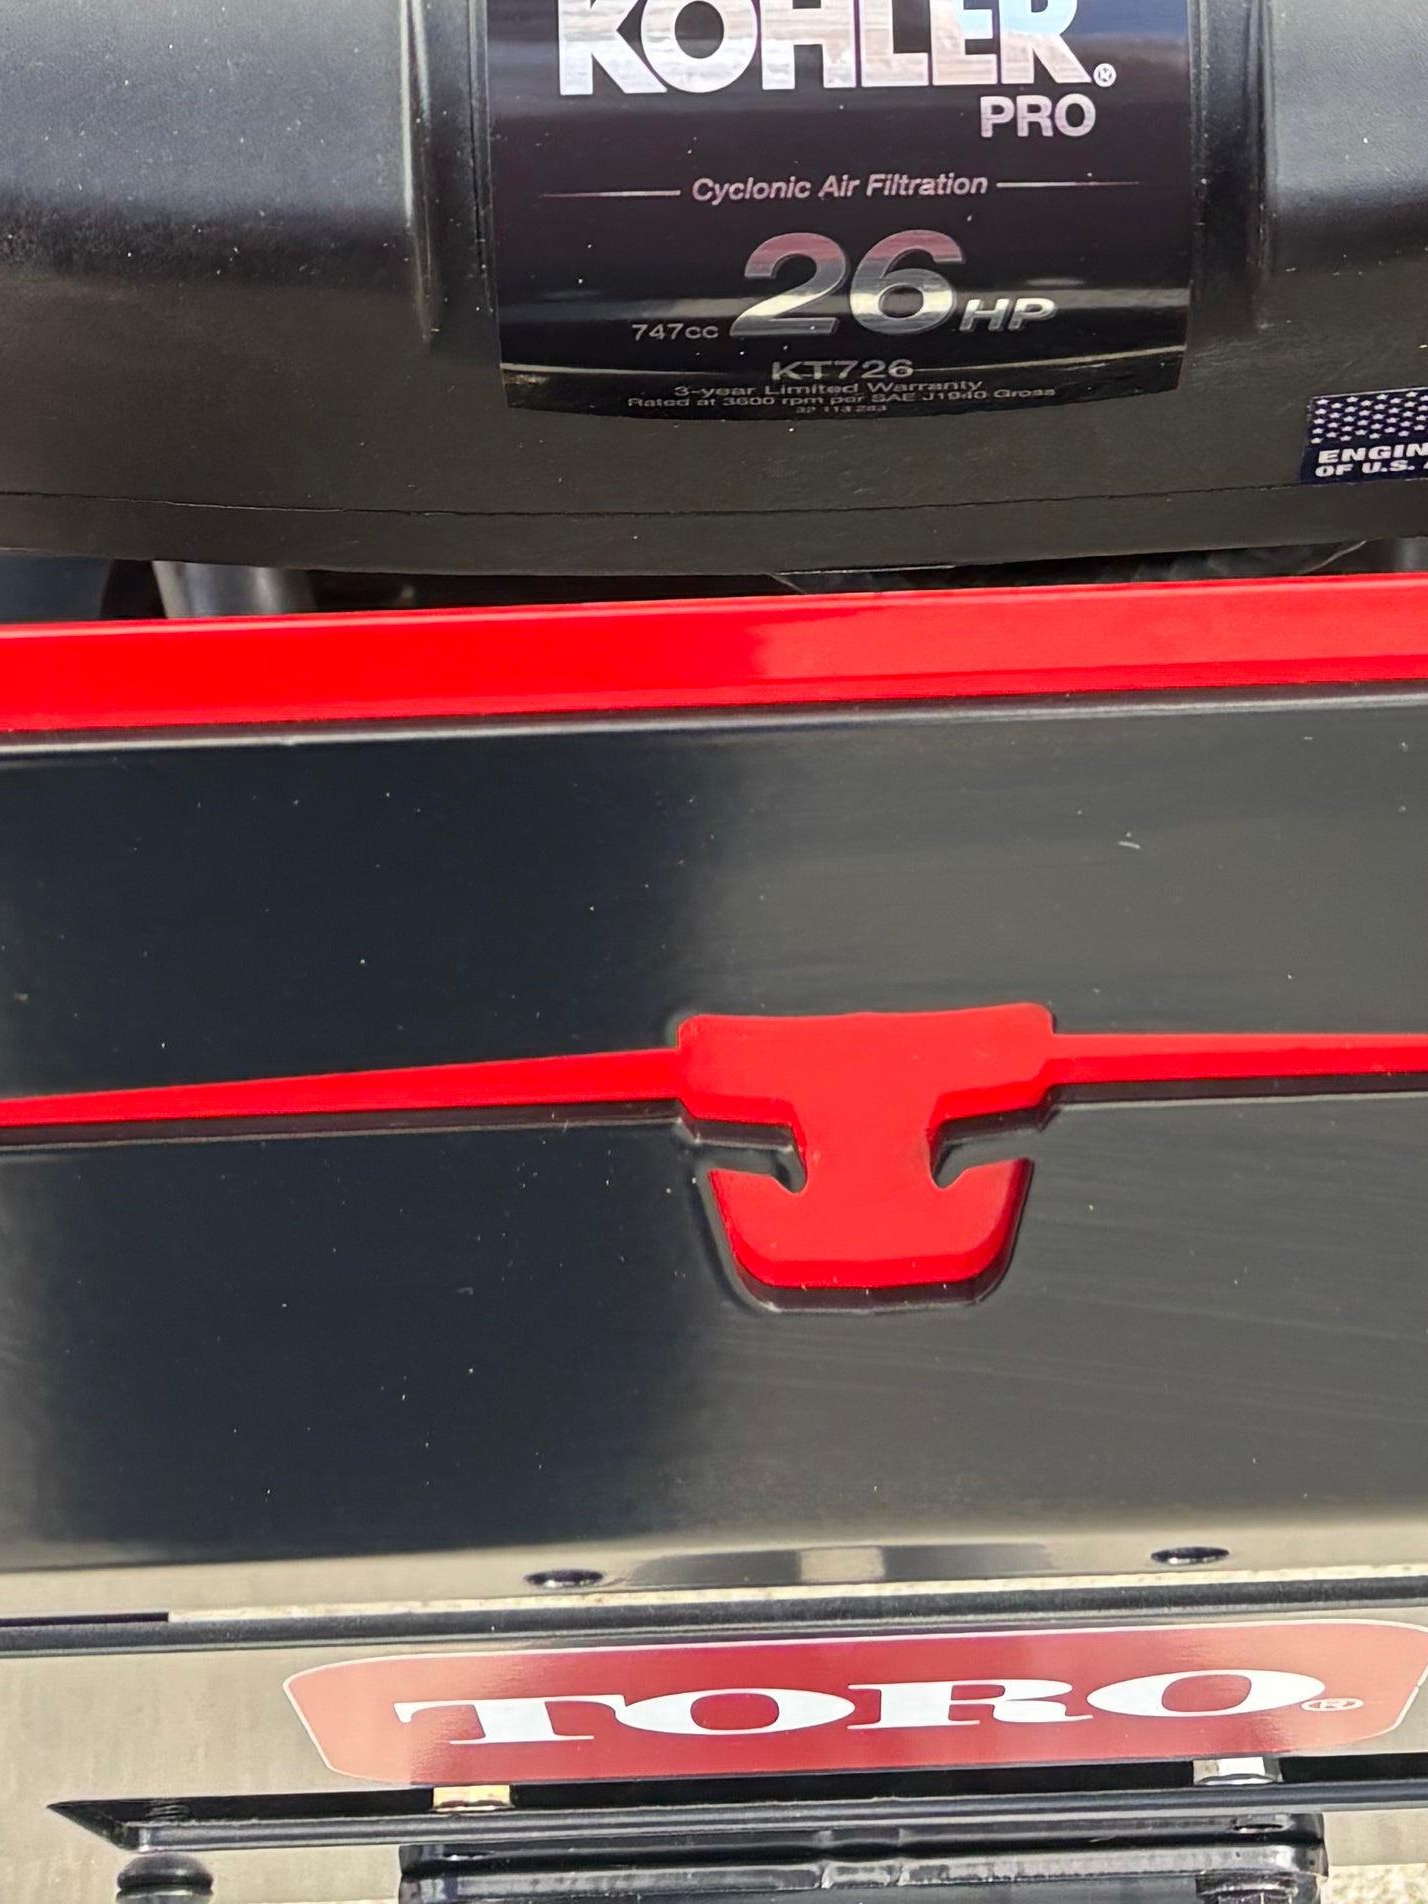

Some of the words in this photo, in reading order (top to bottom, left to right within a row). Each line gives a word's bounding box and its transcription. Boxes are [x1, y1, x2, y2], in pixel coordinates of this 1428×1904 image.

[979, 95, 1097, 139] PRO
[691, 176, 811, 205] Cyclonic
[820, 175, 862, 198] Air
[866, 172, 989, 197] Filtration
[631, 322, 720, 341] 747cc
[729, 228, 966, 337] 26
[959, 296, 1057, 332] HP
[771, 359, 914, 381] KT726
[674, 385, 757, 398] 3-year
[764, 383, 859, 395] Limited
[867, 380, 983, 393] Warranty
[696, 397, 716, 406] at
[781, 396, 824, 406] rpm
[830, 395, 865, 405] per
[871, 392, 916, 403] SAE
[1315, 463, 1354, 478] OF
[1360, 459, 1416, 475] U.S.
[395, 1668, 1327, 1747] TORO
